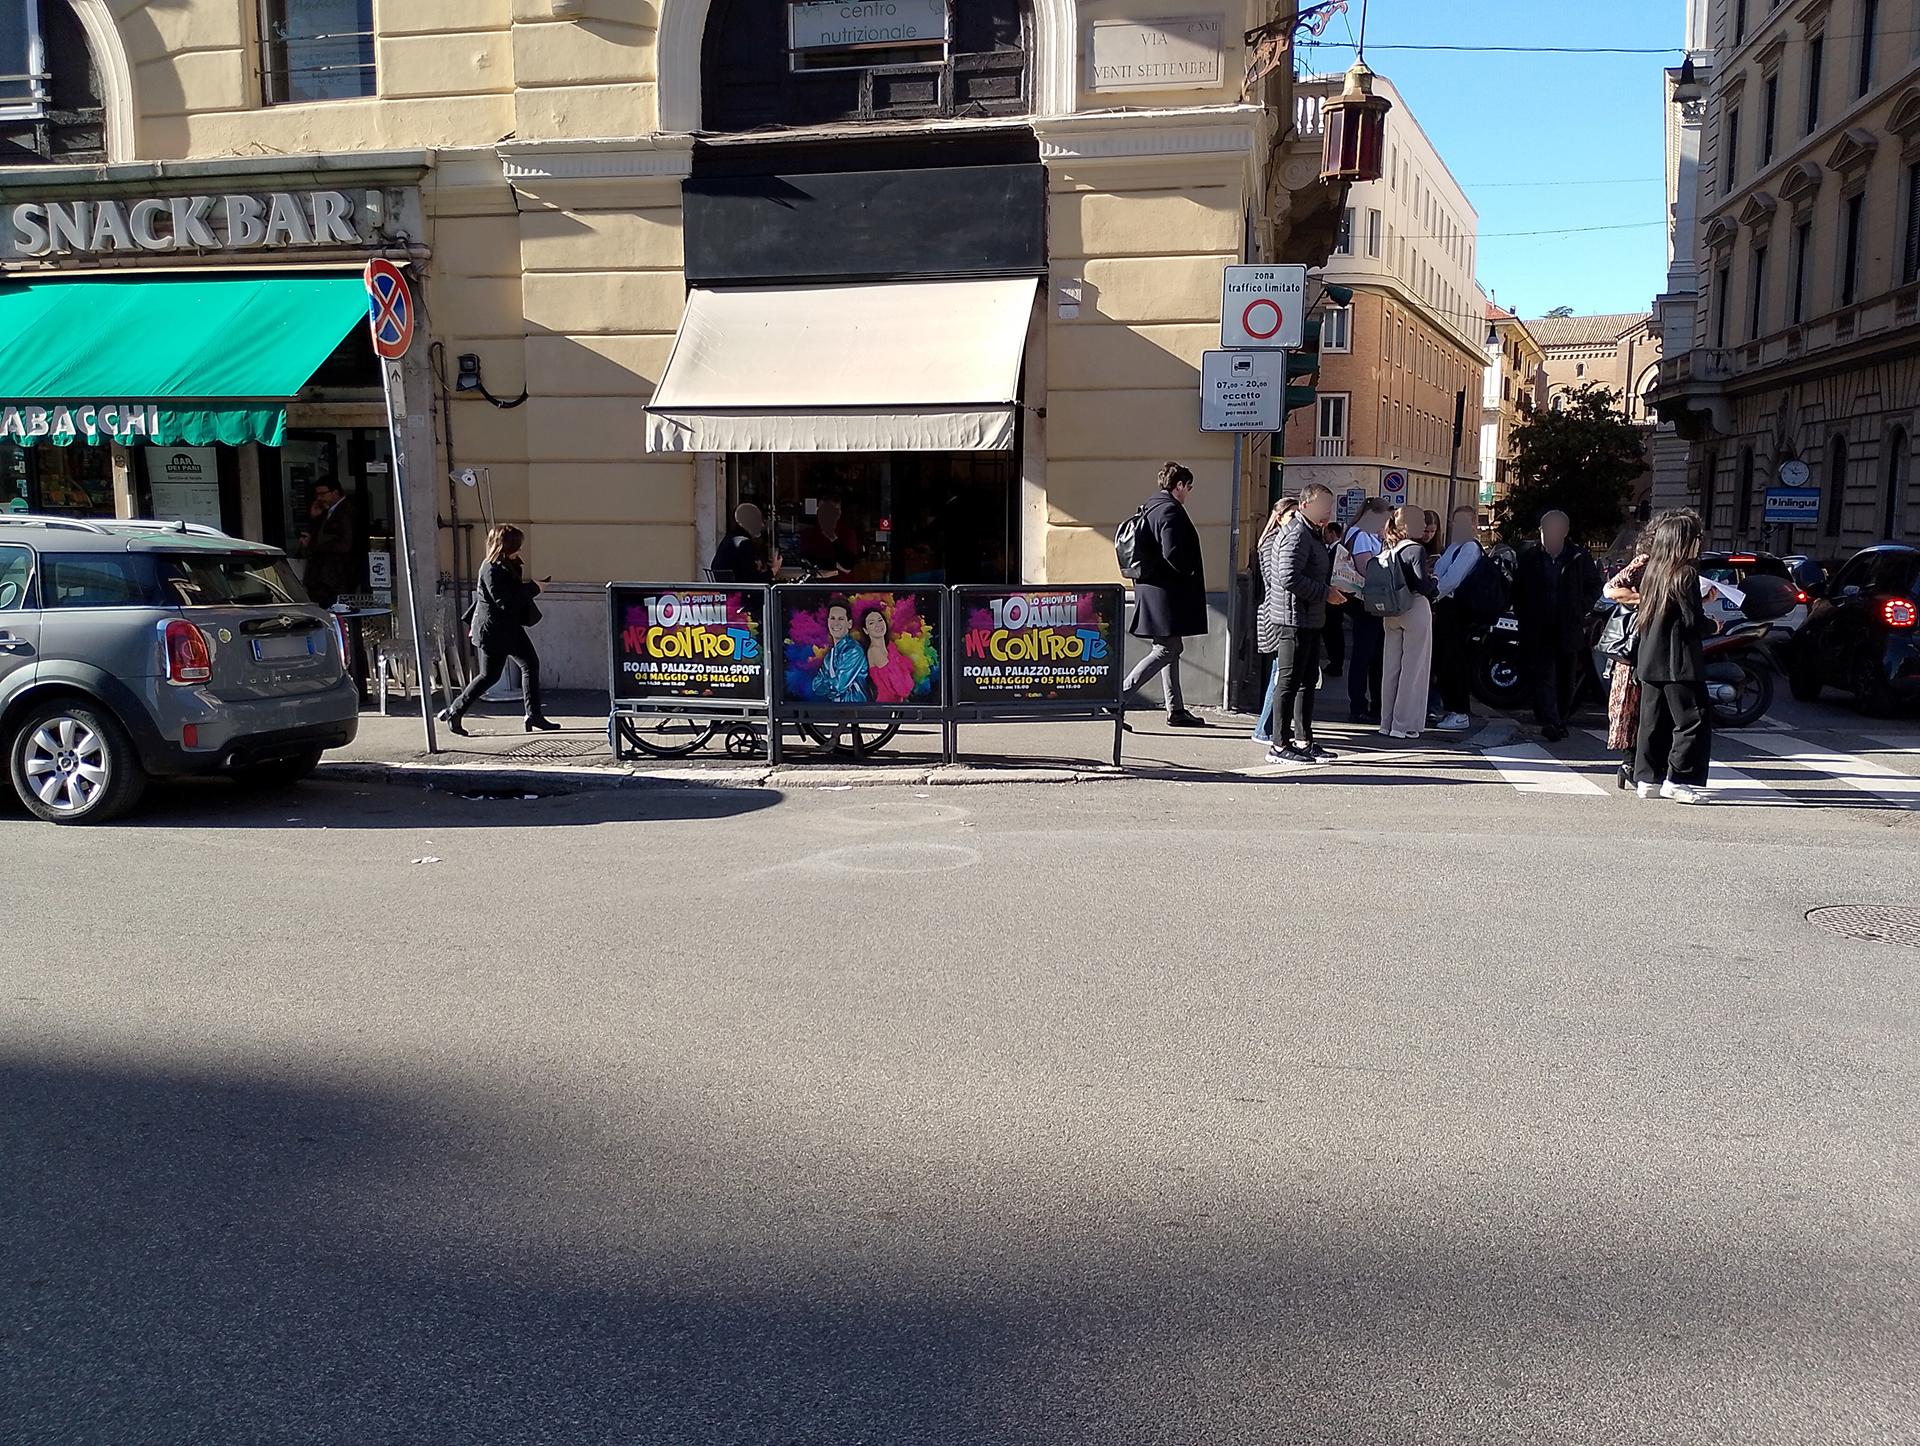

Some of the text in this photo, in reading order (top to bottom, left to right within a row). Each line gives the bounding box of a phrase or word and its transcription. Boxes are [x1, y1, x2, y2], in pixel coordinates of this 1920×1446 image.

[840, 2, 897, 19] centro
[820, 24, 917, 45] nutrizionale
[1141, 33, 1168, 46] VIA
[1093, 64, 1131, 79] VENTI
[13, 190, 363, 257] SNACK BAR
[1254, 272, 1275, 280] zona
[1228, 283, 1301, 293] traffico limitato
[1222, 392, 1261, 400] eccetto
[173, 457, 192, 465] BAR
[1778, 498, 1817, 508] inlingua
[681, 594, 727, 604] LO SHOW DEI
[1029, 594, 1078, 606] LO SHOW DEI
[643, 594, 727, 628] 10 ANNI
[989, 596, 1077, 630] 10 ANNI
[623, 661, 761, 676] ROMA PALAZZO DELLO SPORT
[963, 665, 1110, 677] ROMA PALAZZO DELLO SPORT
[634, 673, 648, 681] 04
[650, 673, 689, 682] MAGGIO
[695, 674, 709, 682] 05
[710, 674, 750, 683] MAGGIO
[975, 676, 990, 685] 04
[991, 676, 1033, 685] MAGGIO
[1040, 676, 1054, 685] 05
[1056, 676, 1097, 684] MAGGIO
